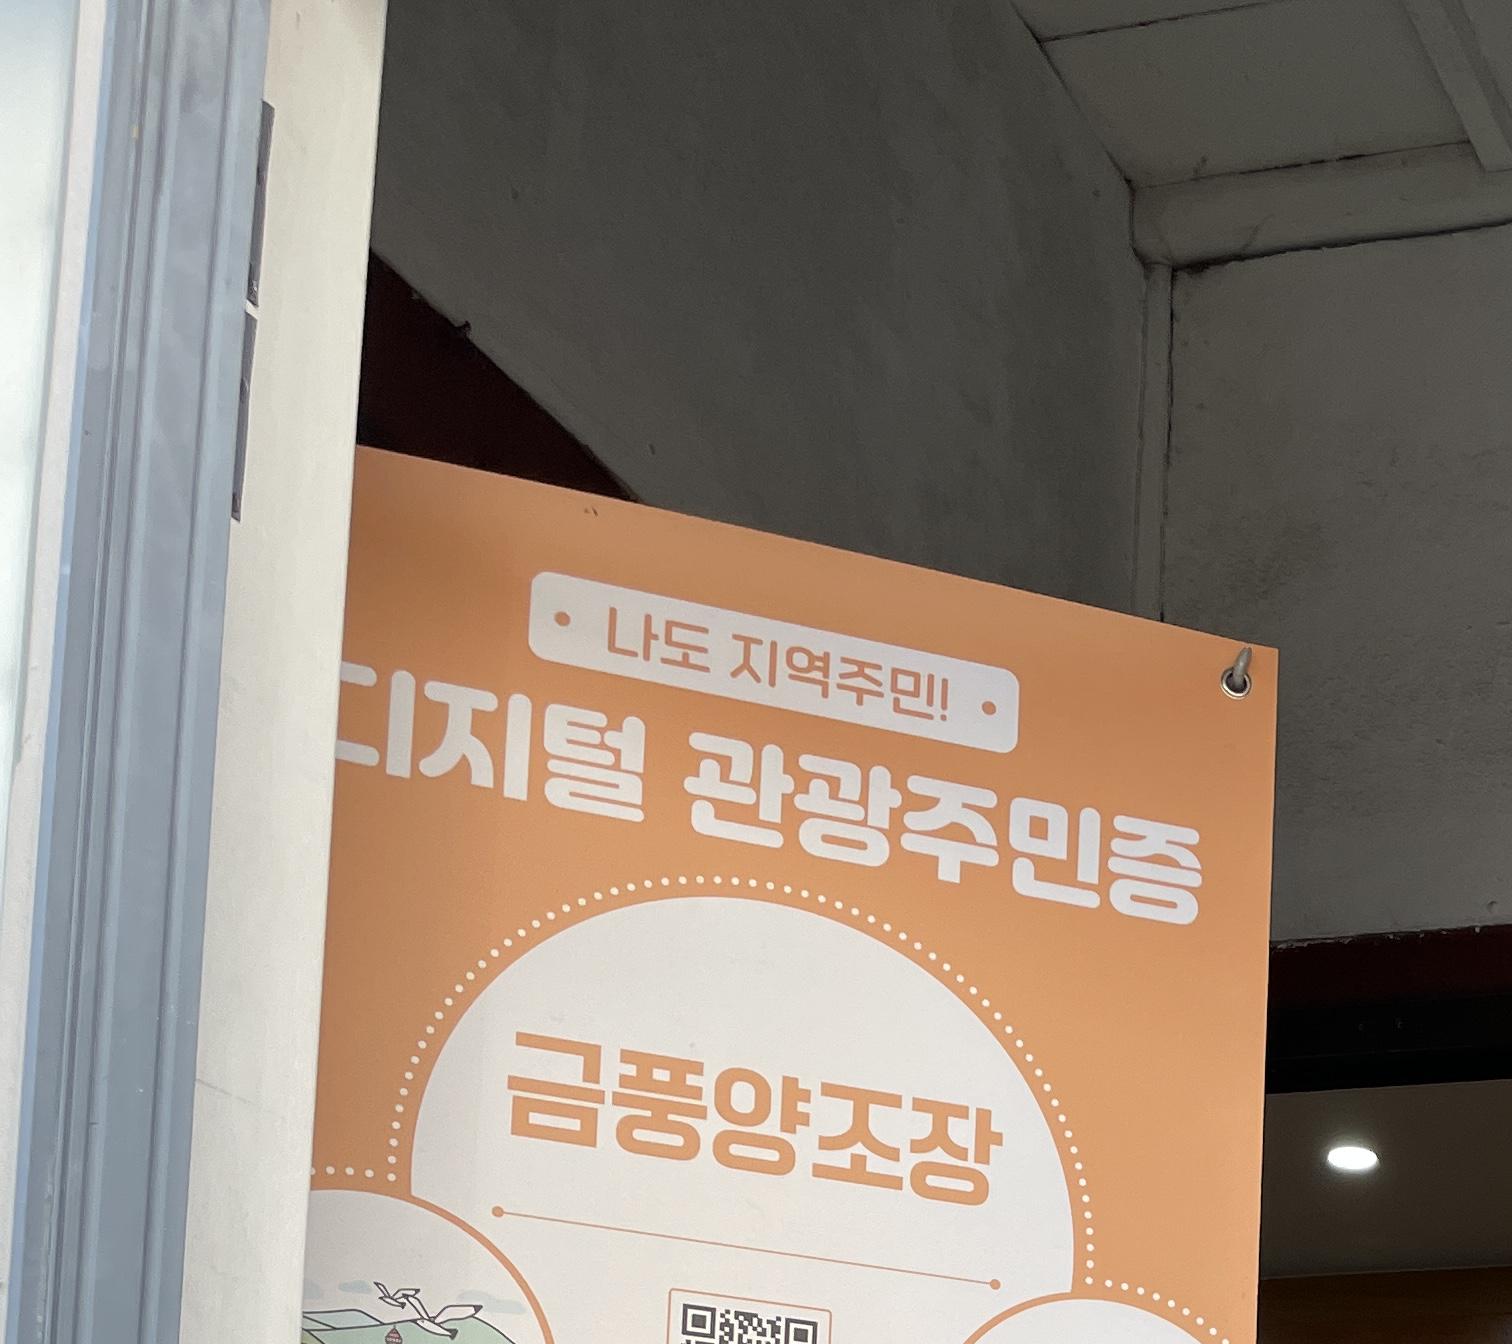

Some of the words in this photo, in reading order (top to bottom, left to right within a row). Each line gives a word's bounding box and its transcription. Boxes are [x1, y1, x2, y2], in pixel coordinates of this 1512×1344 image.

[605, 607, 712, 673] 나도
[730, 633, 951, 721] 지역주민!
[682, 731, 1203, 926] 관광주민증
[506, 1031, 1003, 1207] 금풍양조장
